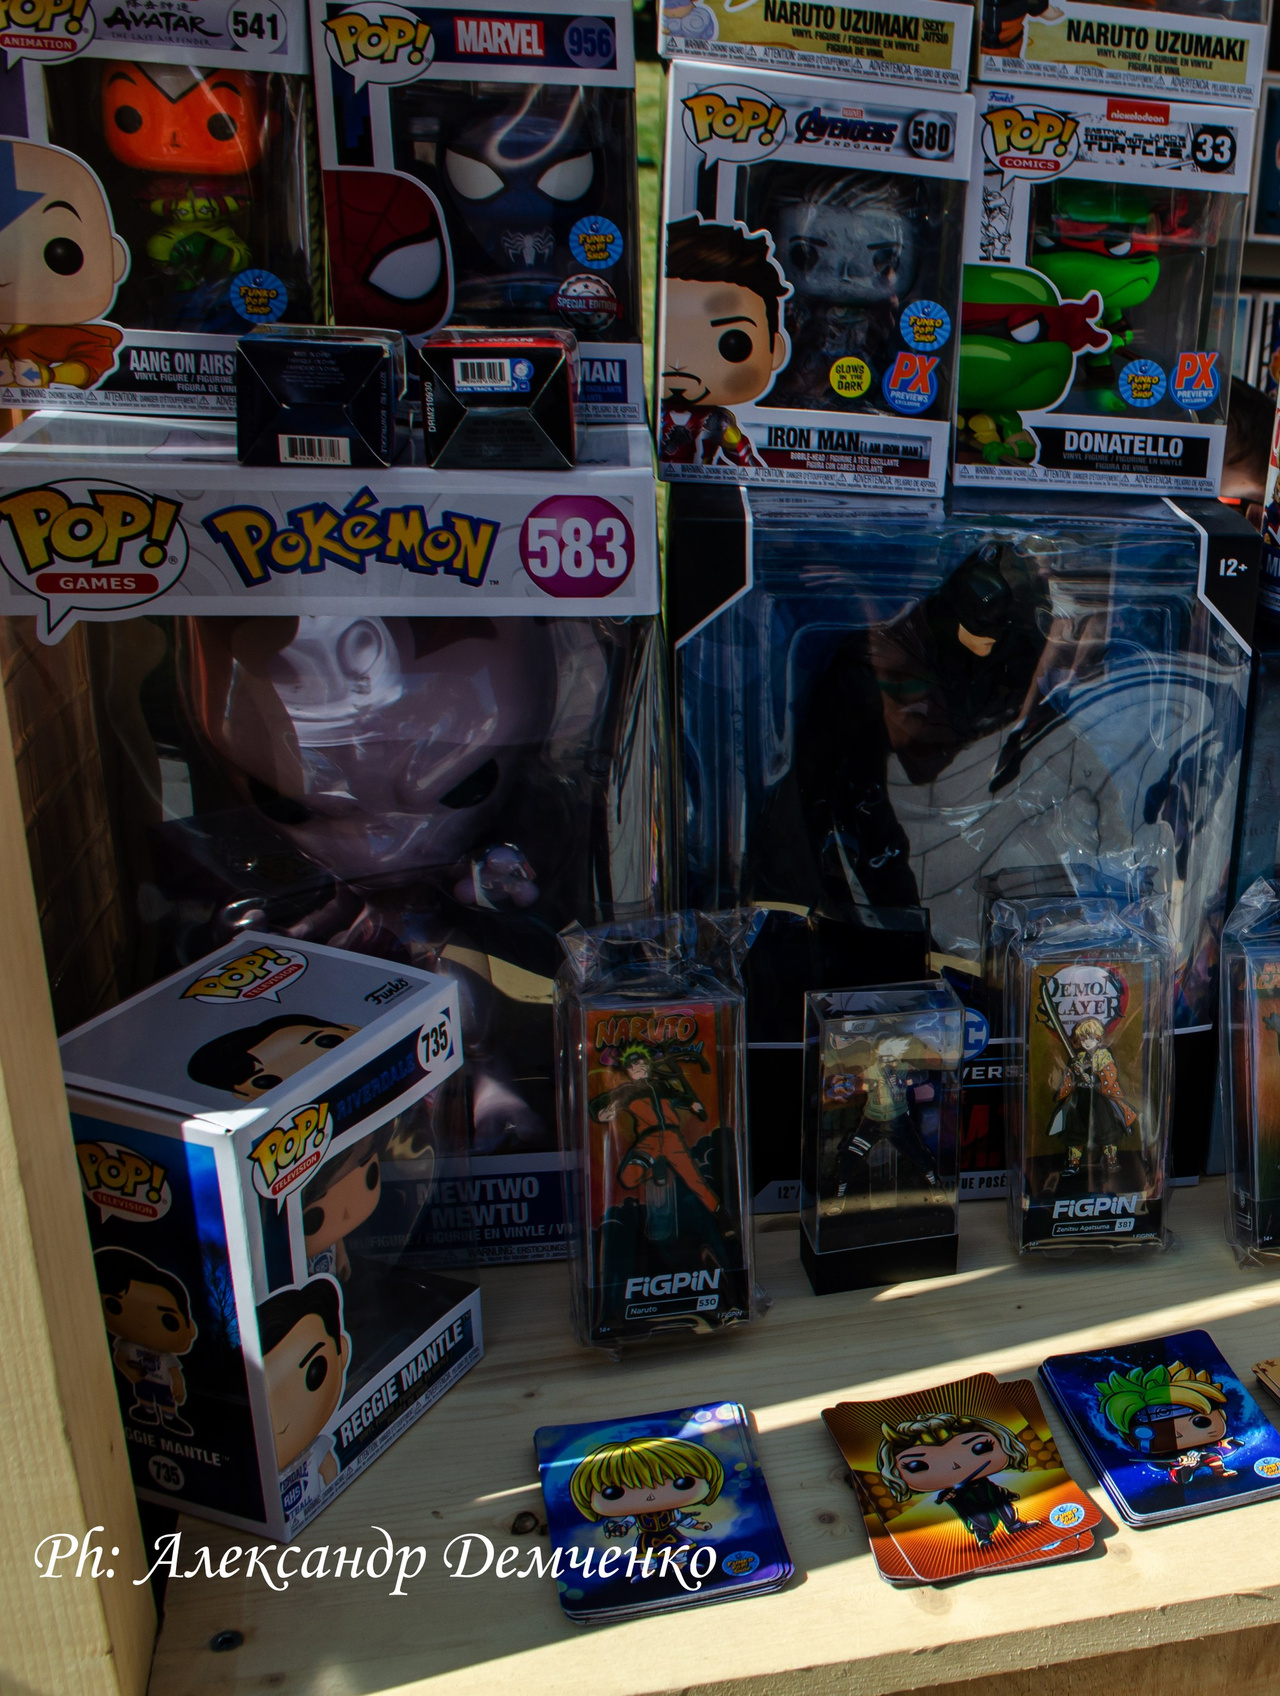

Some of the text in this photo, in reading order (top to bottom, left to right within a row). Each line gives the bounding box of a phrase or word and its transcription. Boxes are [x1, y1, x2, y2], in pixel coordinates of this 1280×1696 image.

[103, 7, 224, 37] AVATAR
[232, 11, 279, 40] 541
[763, 0, 920, 41] NARUTO UZUMAKI
[3, 35, 73, 50] ANIMATION
[322, 13, 431, 66] POP!
[457, 19, 545, 56] MARVEL
[568, 27, 613, 58] 956
[1066, 19, 1245, 62] NARUTO UZUMAKI
[681, 93, 786, 146] POP!
[795, 107, 898, 144] AVENGERS
[1110, 109, 1165, 124] nickelodeon
[824, 140, 892, 152] ENDGAME
[911, 121, 950, 152] 580
[981, 107, 1079, 157] POP!
[1083, 140, 1183, 158] TURTLES
[1195, 133, 1231, 164] 33
[1004, 158, 1056, 170] COMICS
[589, 299, 617, 312] EDITION
[909, 316, 942, 328] FUNKO
[130, 350, 195, 375] AANG ON
[835, 365, 865, 375] GLOWS
[889, 351, 940, 394] PX
[1175, 351, 1220, 390] PX
[837, 380, 864, 391] DARK
[1127, 375, 1160, 385] FUNKO
[1132, 390, 1153, 399] SHOP
[1177, 389, 1214, 399] PREVIEWS
[428, 381, 437, 433] DRM210930
[889, 391, 929, 403] PREVIEWS
[767, 426, 861, 452] IRON MAN
[1064, 430, 1184, 459] DONATELLO
[0, 487, 183, 574] POP!
[526, 516, 628, 579] 583
[1218, 558, 1248, 577] 12+
[59, 575, 137, 591] GAMES
[180, 946, 293, 1000] POP!
[246, 964, 300, 998] TELEVISION
[1038, 974, 1124, 1000] DEMON
[365, 977, 409, 1006] Funko
[1035, 998, 1125, 1026] SLAYER
[421, 1021, 448, 1063] 735
[595, 1016, 696, 1048] NARUTO
[336, 1052, 417, 1122] RIVERDALE
[251, 1101, 332, 1188] POP!
[76, 1142, 169, 1205] POP!
[272, 1154, 319, 1195] TELEVISION
[97, 1193, 154, 1216] TELEVISION
[416, 1176, 539, 1205] MEWTWO
[432, 1201, 529, 1229] MEWTU
[1056, 1224, 1078, 1233] Zenitsu
[1117, 1220, 1132, 1229] 381
[504, 1223, 546, 1239] VINYLE
[630, 1304, 658, 1315] Naruto
[699, 1297, 717, 1308] 530
[339, 1376, 400, 1449] REGGIE
[400, 1319, 464, 1391] MANTLE
[160, 1438, 222, 1468] MANTLE
[151, 1460, 181, 1486] 735
